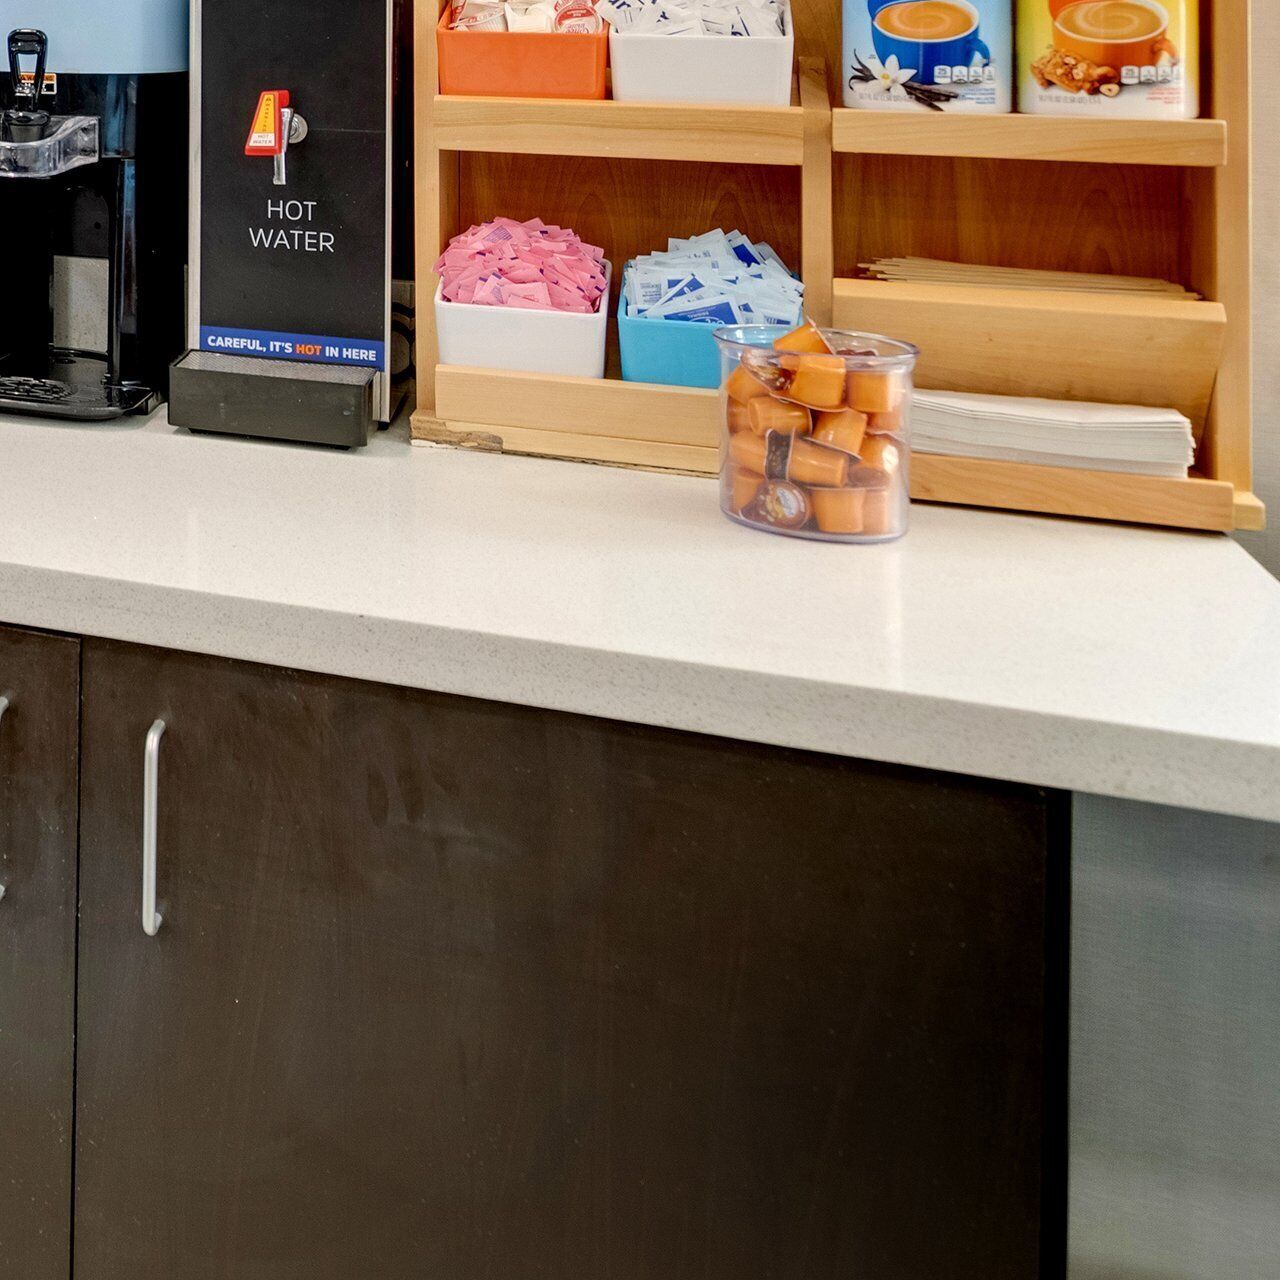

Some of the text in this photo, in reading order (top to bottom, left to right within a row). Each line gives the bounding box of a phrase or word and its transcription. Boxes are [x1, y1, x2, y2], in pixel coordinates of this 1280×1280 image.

[267, 199, 317, 221] HOT
[249, 227, 335, 253] WATER
[207, 335, 377, 361] CAREFUL, IT'S HOT IN HERE
